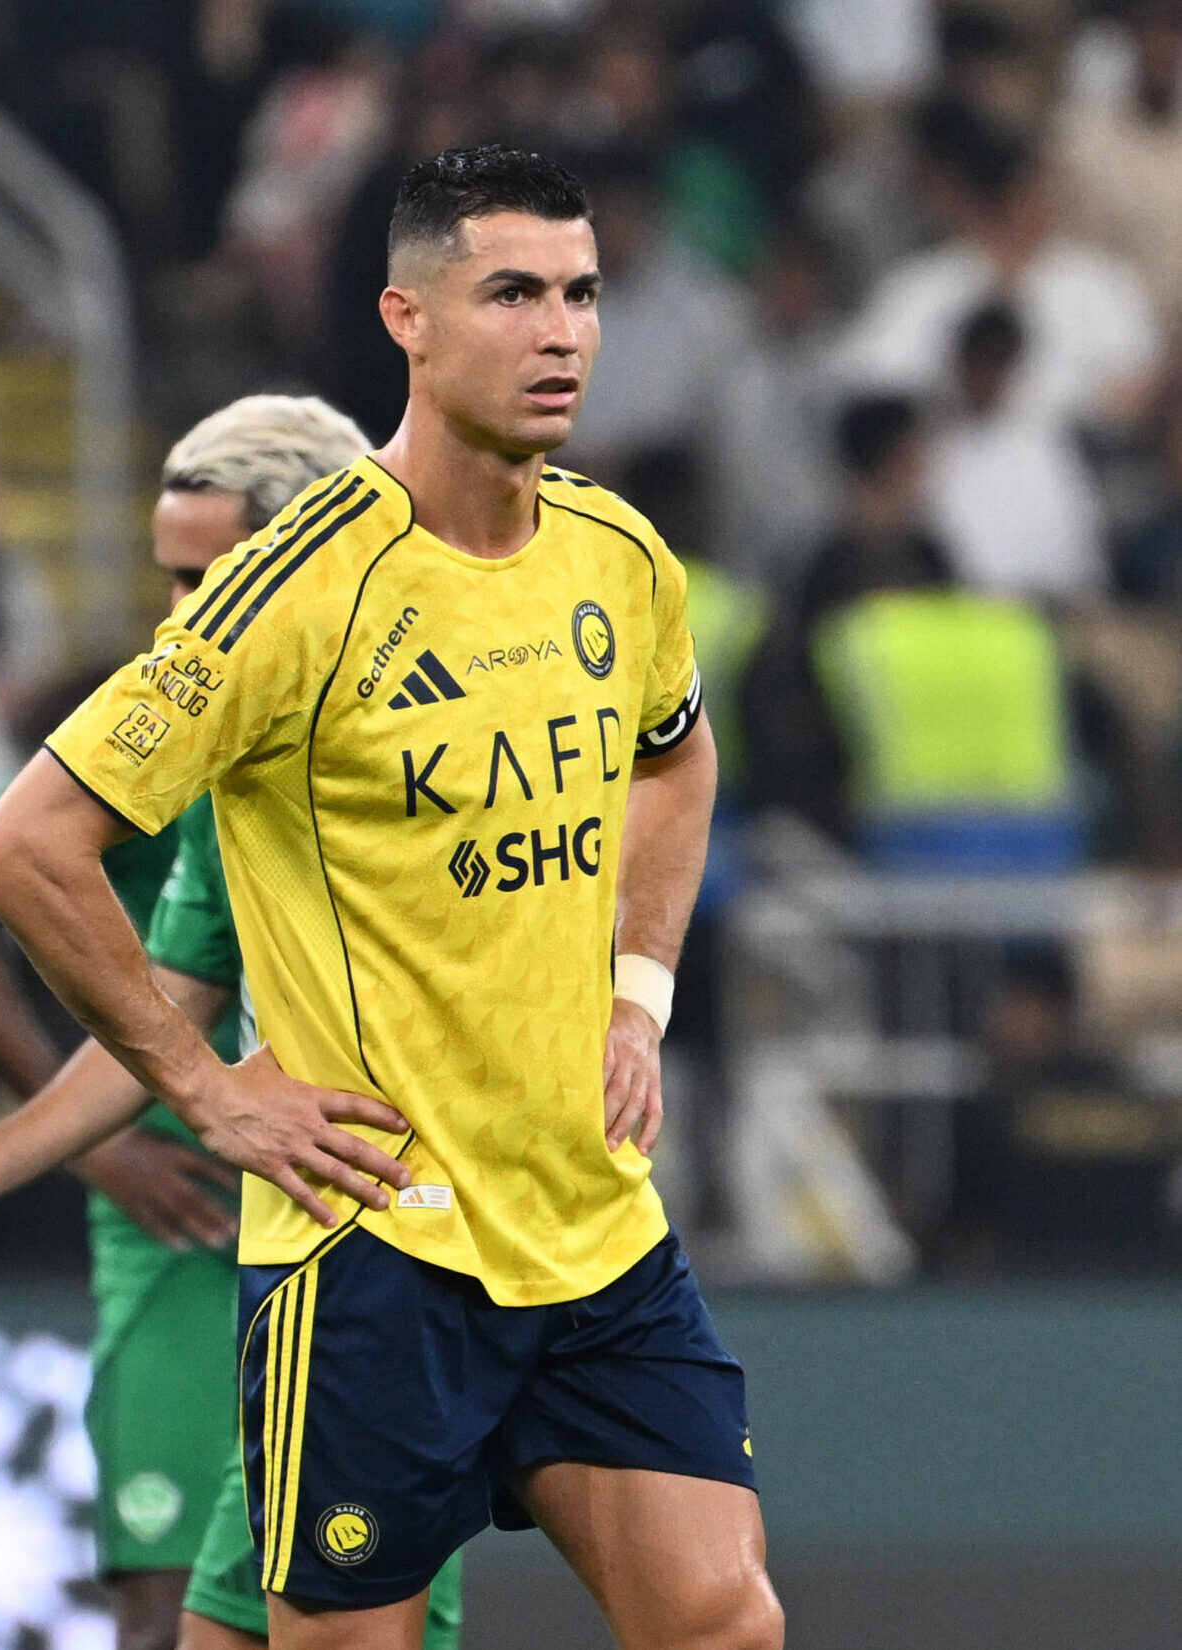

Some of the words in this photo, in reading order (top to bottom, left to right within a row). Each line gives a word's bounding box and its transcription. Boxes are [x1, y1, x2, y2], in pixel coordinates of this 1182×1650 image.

[356, 606, 420, 699] Gathern
[466, 639, 563, 676] AROYA
[156, 670, 209, 718] NOUG
[401, 706, 620, 818] KAFD
[495, 816, 602, 893] SHG
